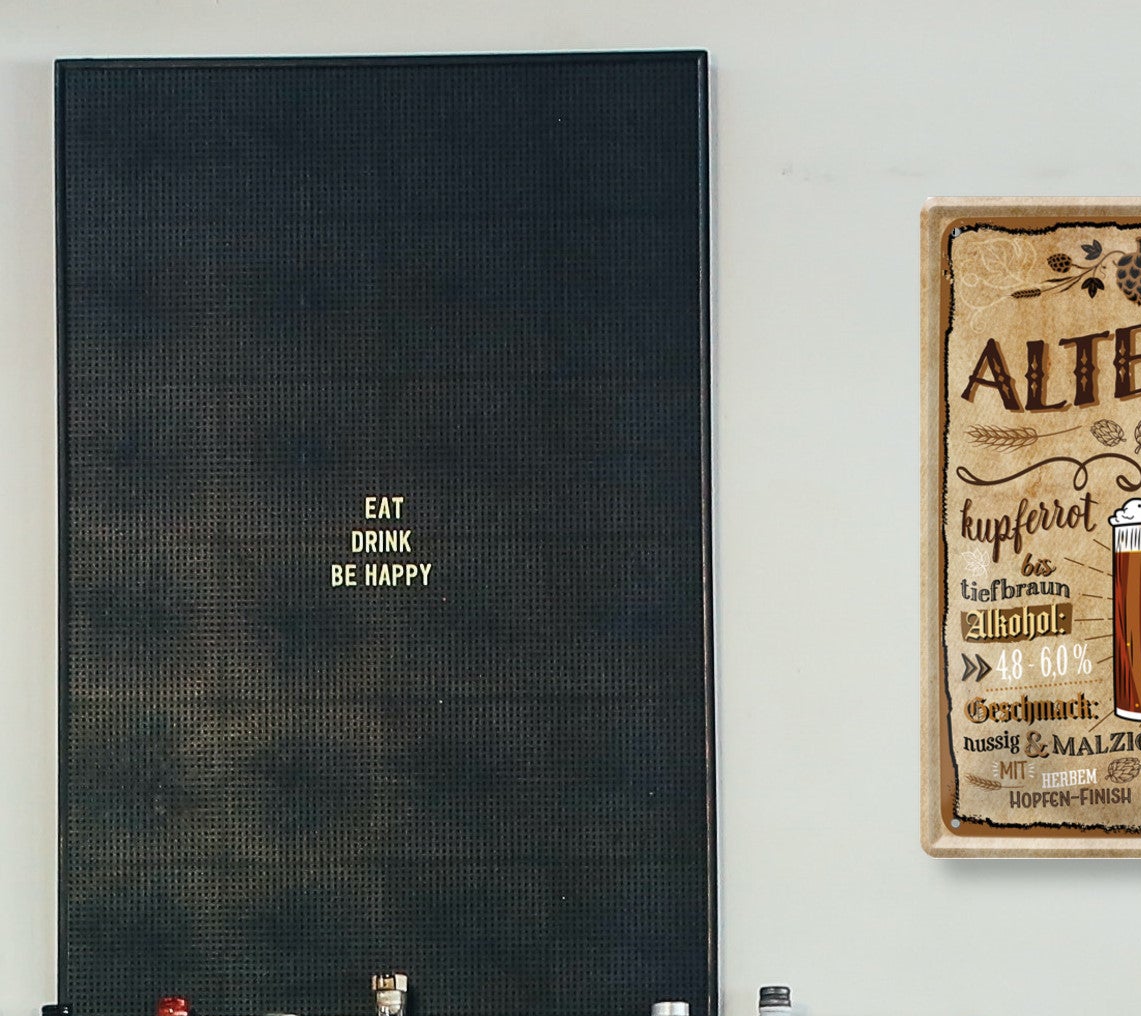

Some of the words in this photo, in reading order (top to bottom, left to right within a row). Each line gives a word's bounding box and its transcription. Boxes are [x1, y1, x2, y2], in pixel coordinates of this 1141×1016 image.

[365, 496, 404, 519] EAT
[960, 492, 1099, 563] kupferrot
[351, 530, 411, 553] DRINK
[331, 564, 357, 587] BE
[365, 563, 432, 587] HAPPY
[1020, 552, 1057, 578] bis
[960, 577, 1071, 603] tiefbraun
[965, 603, 1067, 642] Alkohol:
[995, 648, 1023, 685] 4,8
[1040, 644, 1069, 681] 6,0
[965, 694, 1100, 725] Geschmack:
[962, 731, 1021, 755] nussig
[1023, 730, 1050, 758] &
[998, 760, 1028, 780] MIT
[1040, 767, 1098, 789] HERBEM
[1009, 786, 1132, 809] HOPFEN-FINISH
